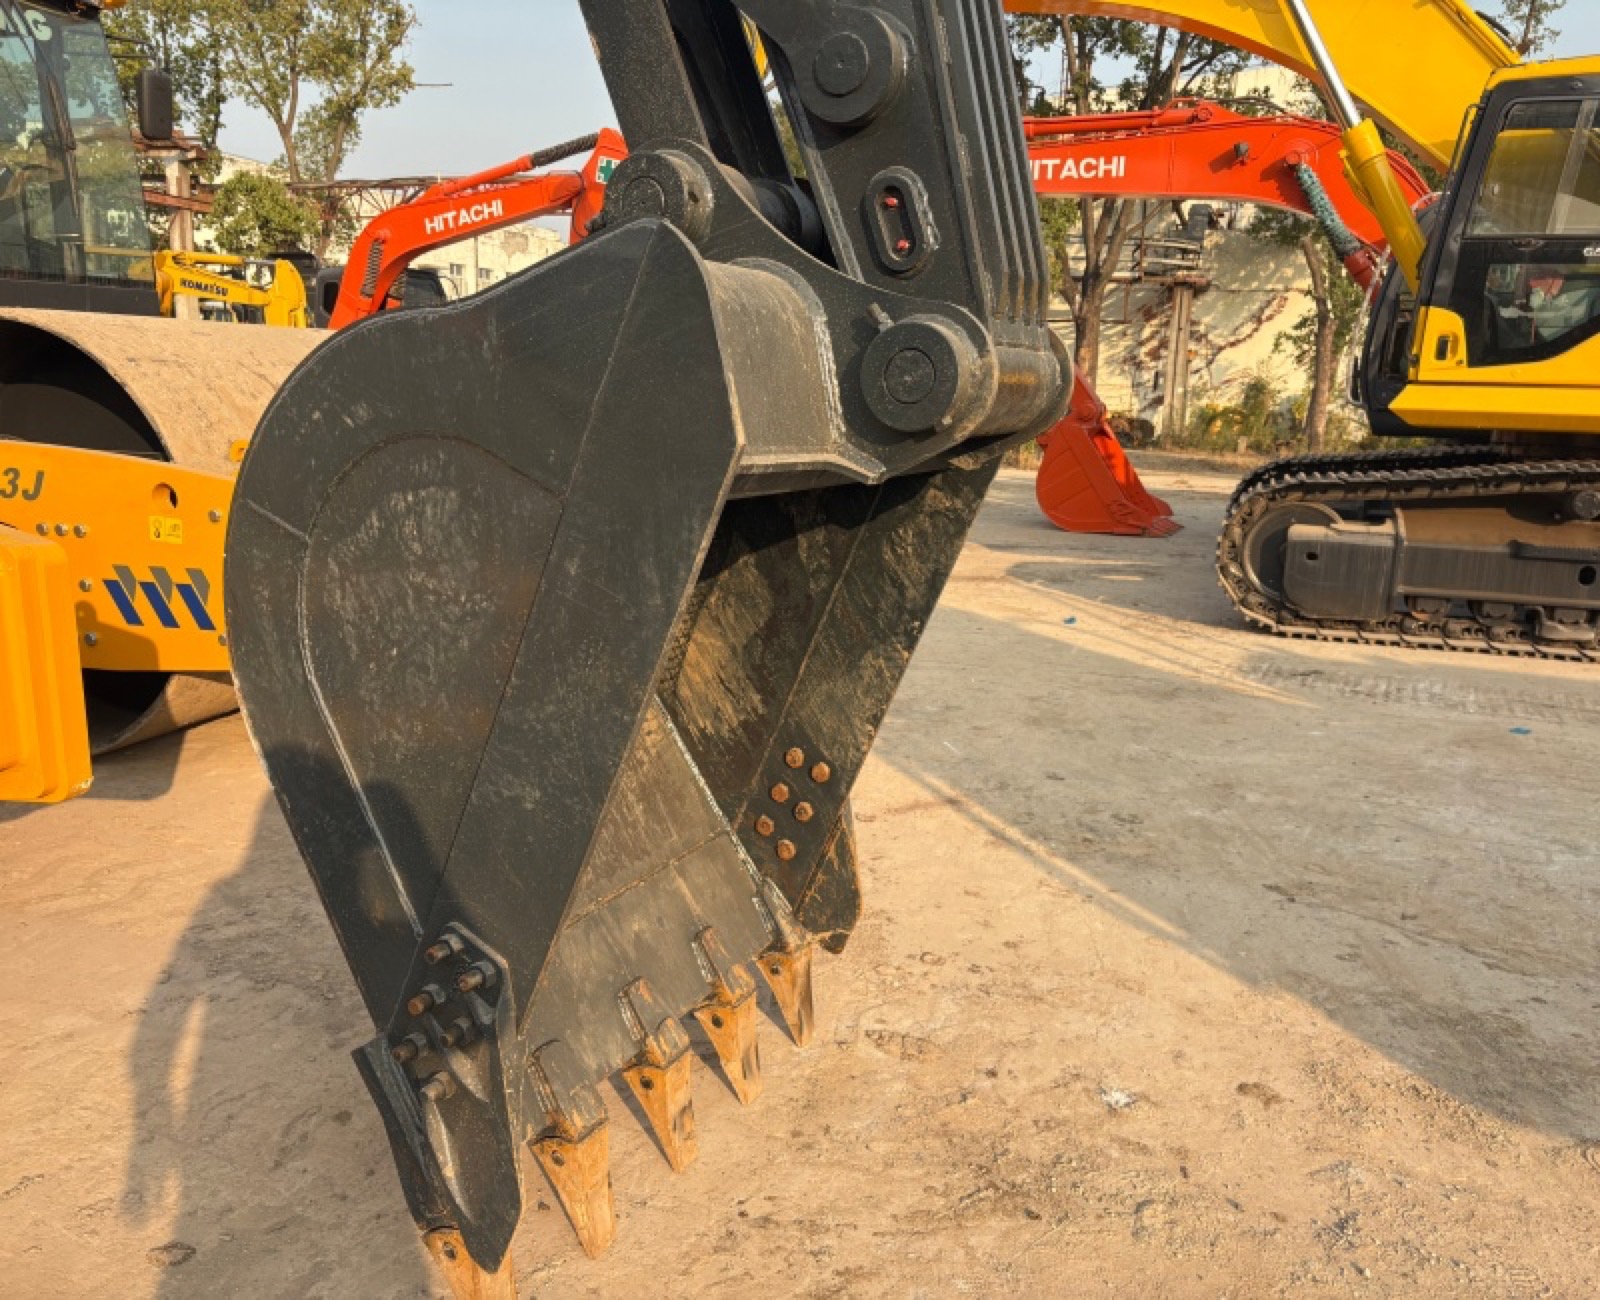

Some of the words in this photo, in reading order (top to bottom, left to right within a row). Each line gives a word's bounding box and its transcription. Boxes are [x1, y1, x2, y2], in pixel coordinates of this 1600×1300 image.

[424, 198, 503, 235] HITACHI
[180, 278, 228, 296] KOMATSU
[0, 467, 45, 500] 3J
